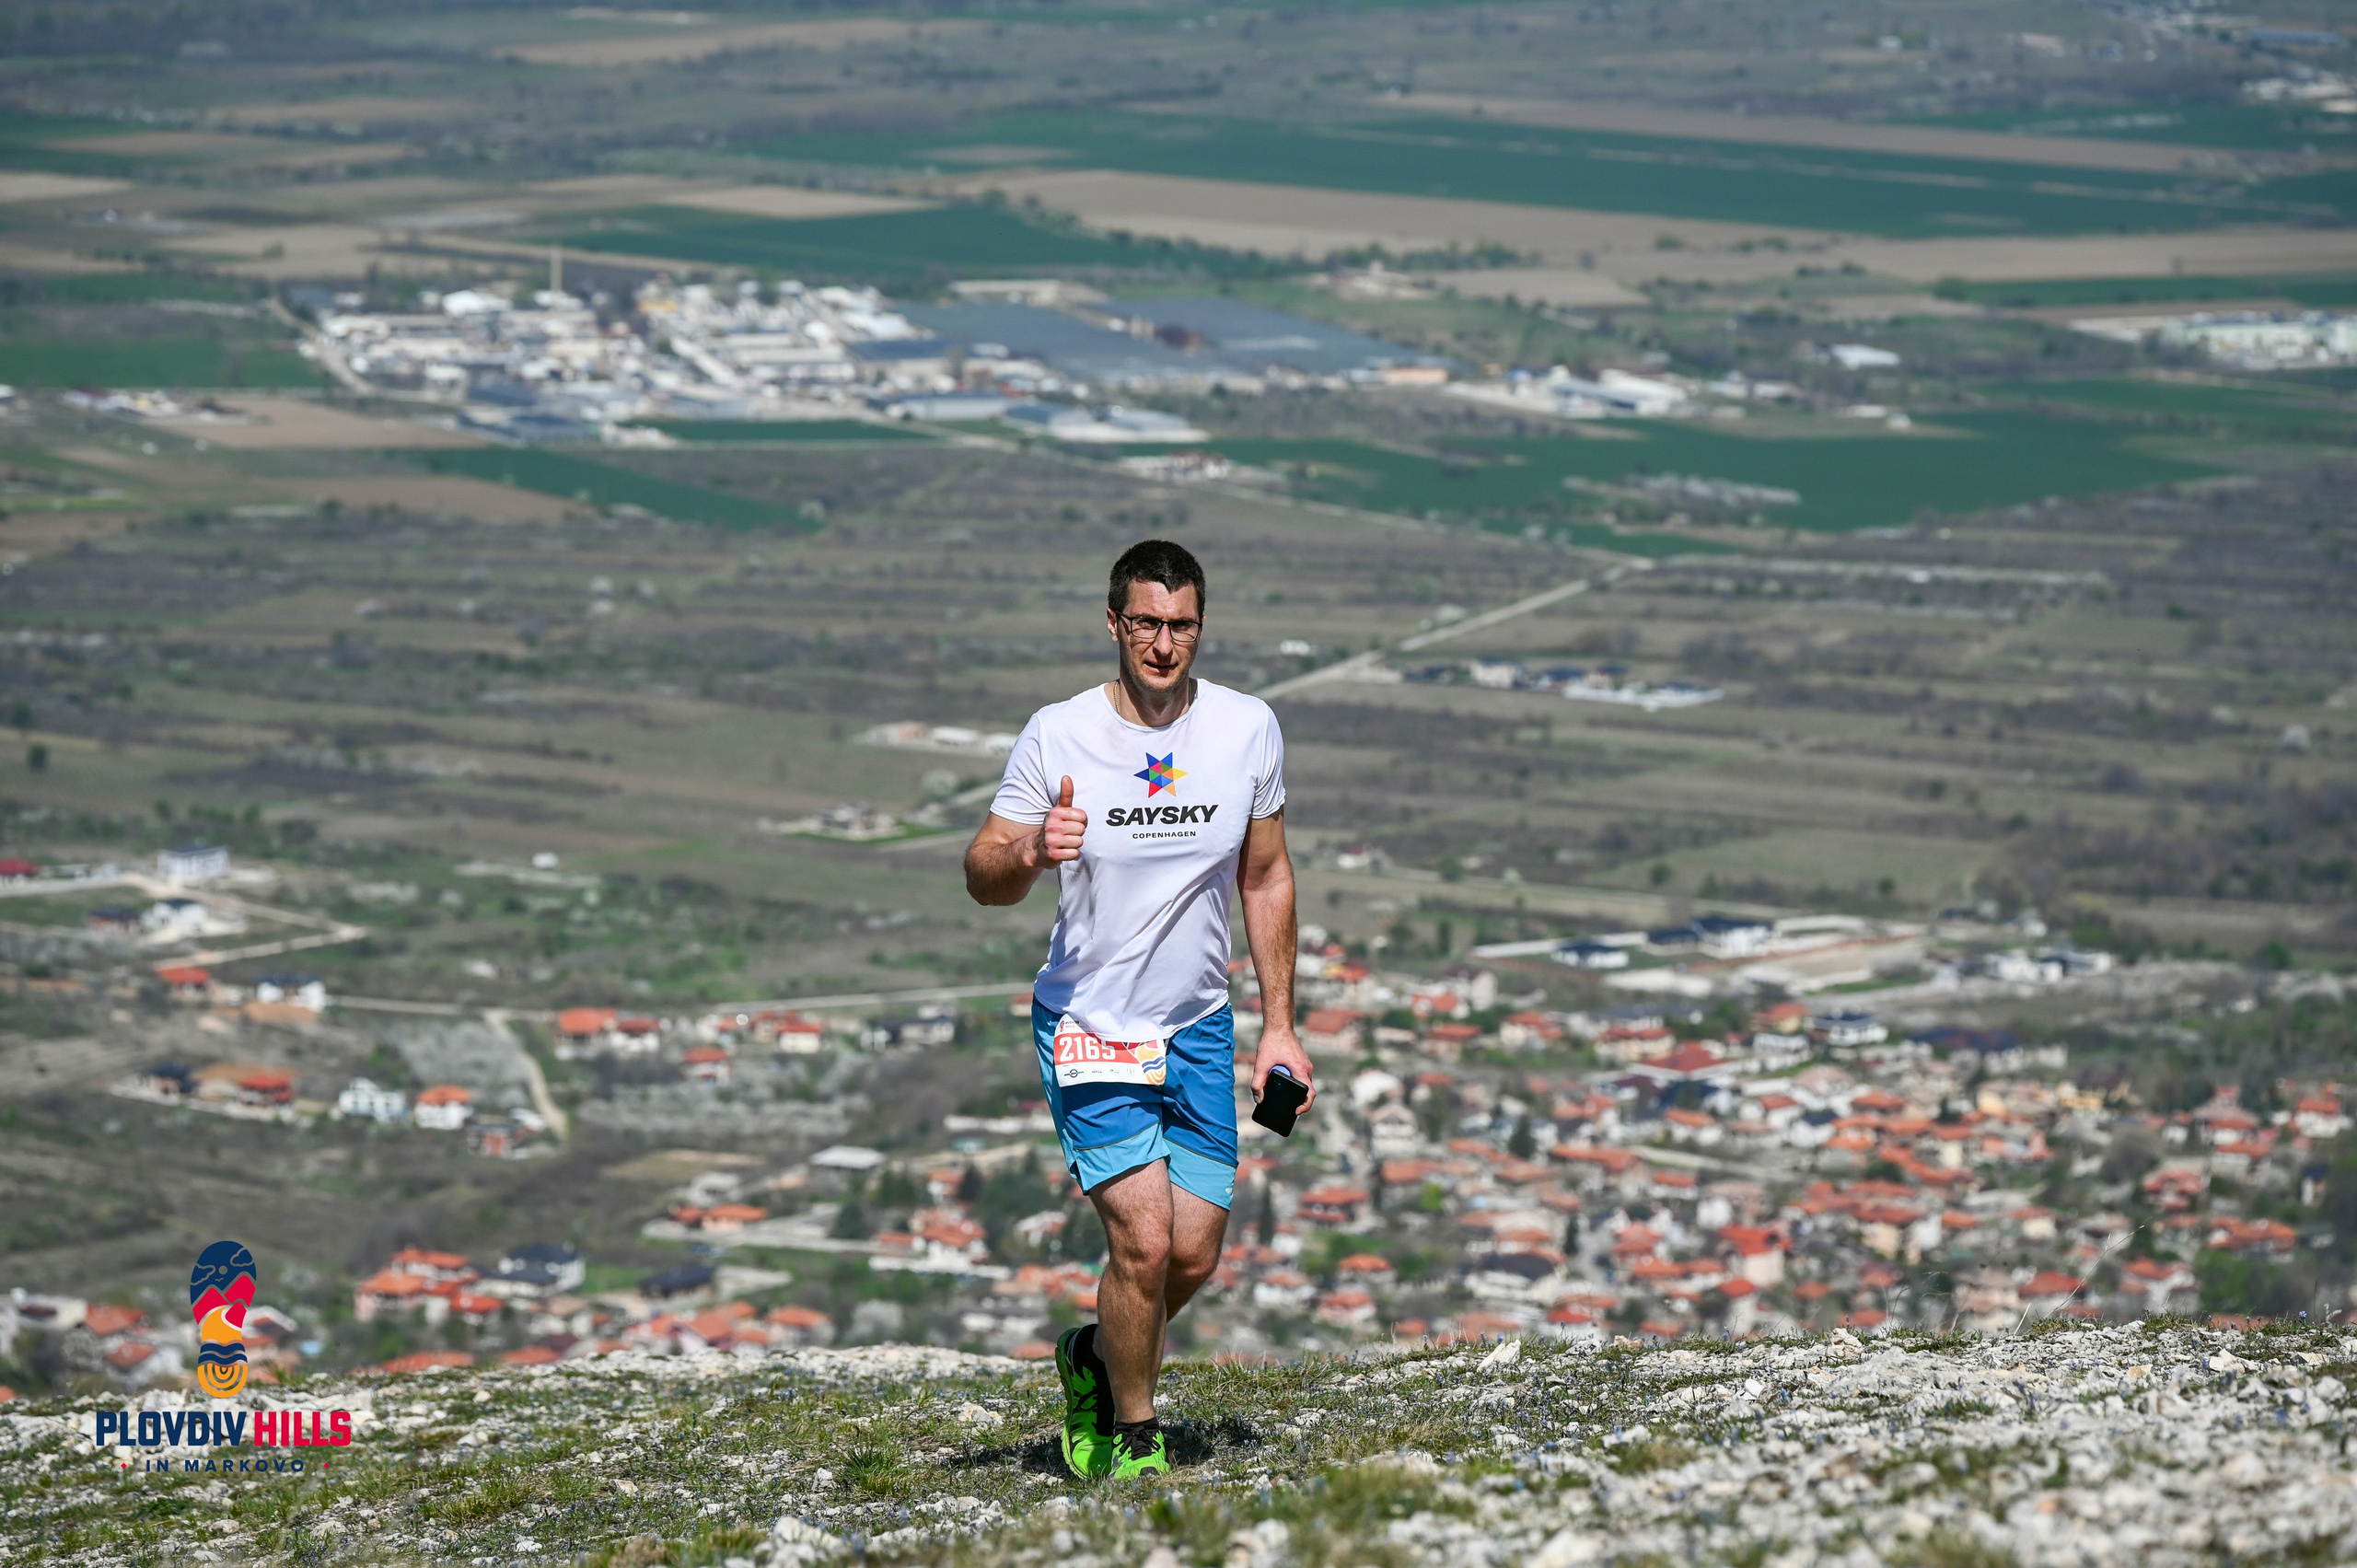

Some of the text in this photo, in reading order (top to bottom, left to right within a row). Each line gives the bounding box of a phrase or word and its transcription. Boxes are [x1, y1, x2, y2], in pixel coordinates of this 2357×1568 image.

[1106, 804, 1219, 827] SAYSKY
[1132, 830, 1196, 840] COPENHAGEN
[1059, 1036, 1116, 1062] 2165
